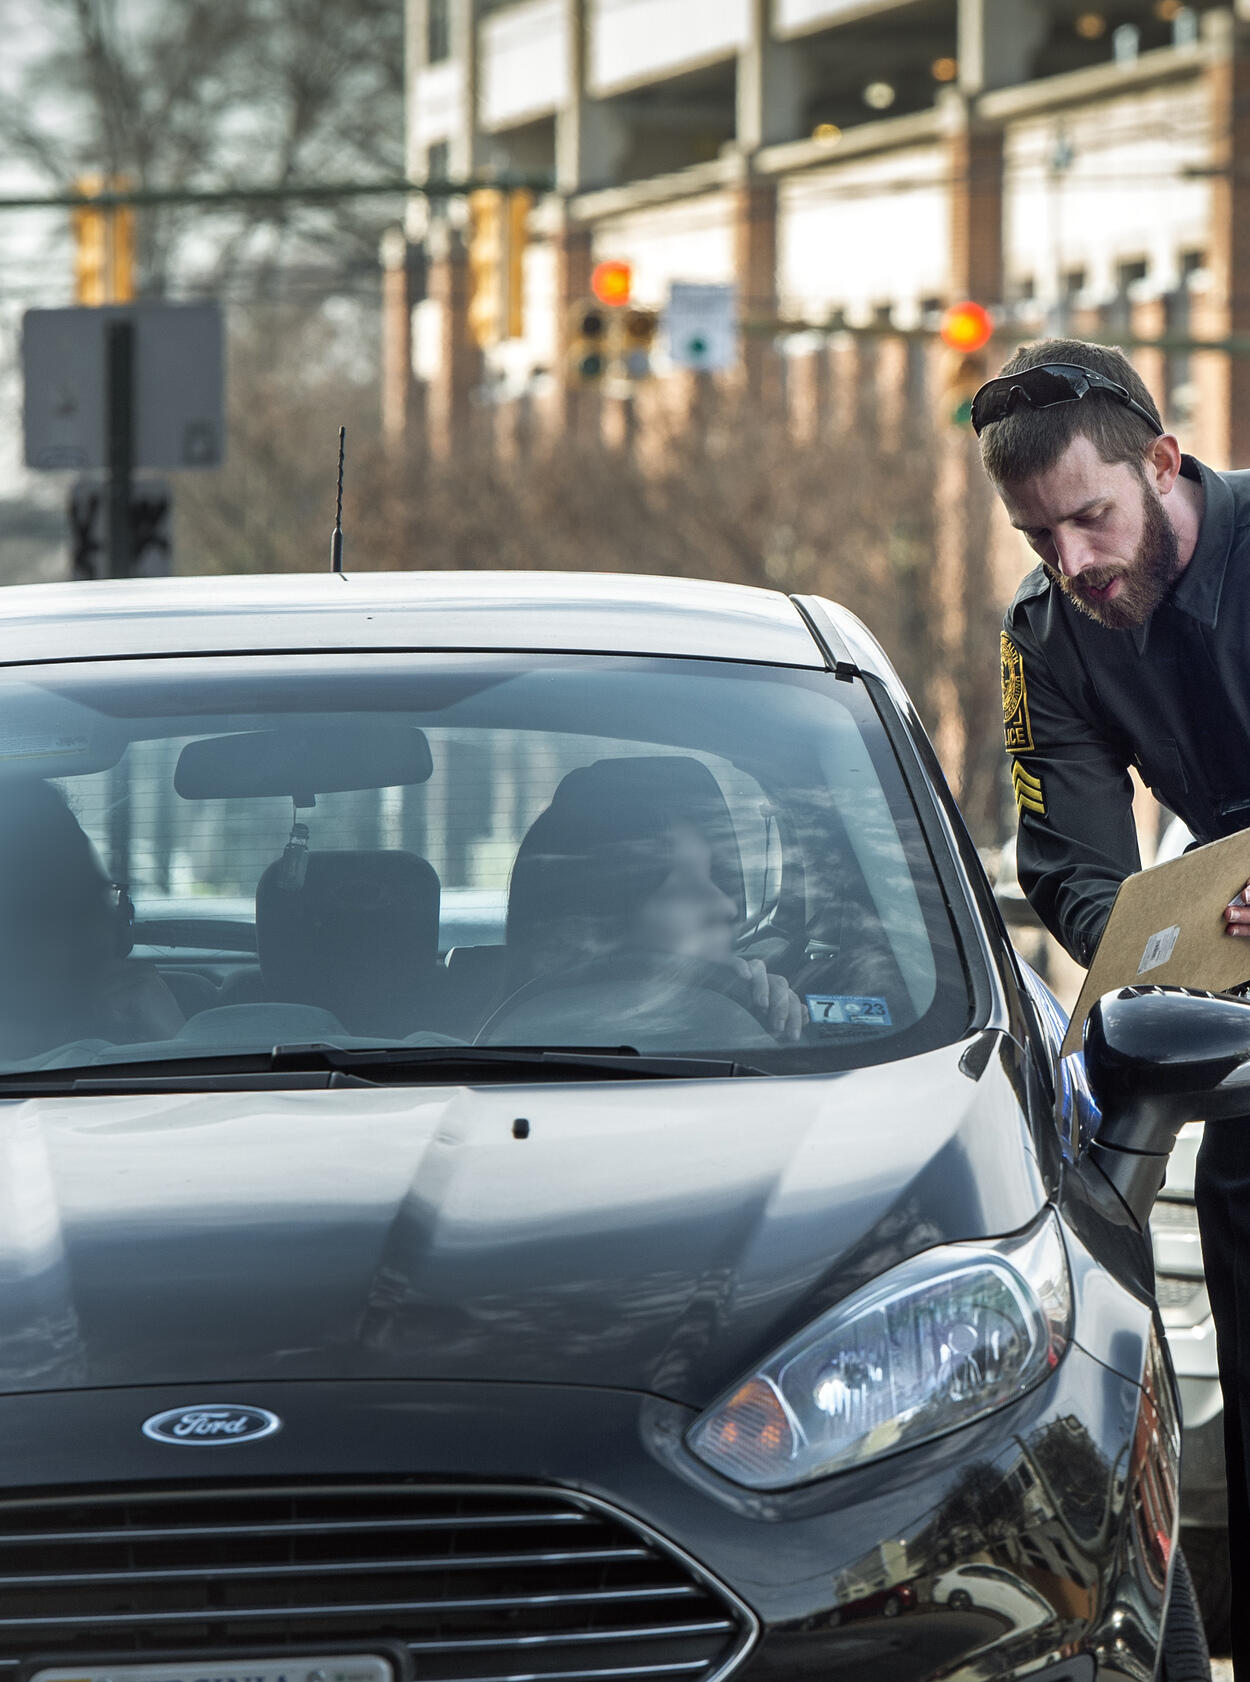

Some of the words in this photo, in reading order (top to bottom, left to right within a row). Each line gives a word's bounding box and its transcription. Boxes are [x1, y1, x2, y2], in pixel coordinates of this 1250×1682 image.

[816, 1001, 834, 1017] 7
[863, 1003, 885, 1015] 23
[173, 1412, 248, 1436] Ford
